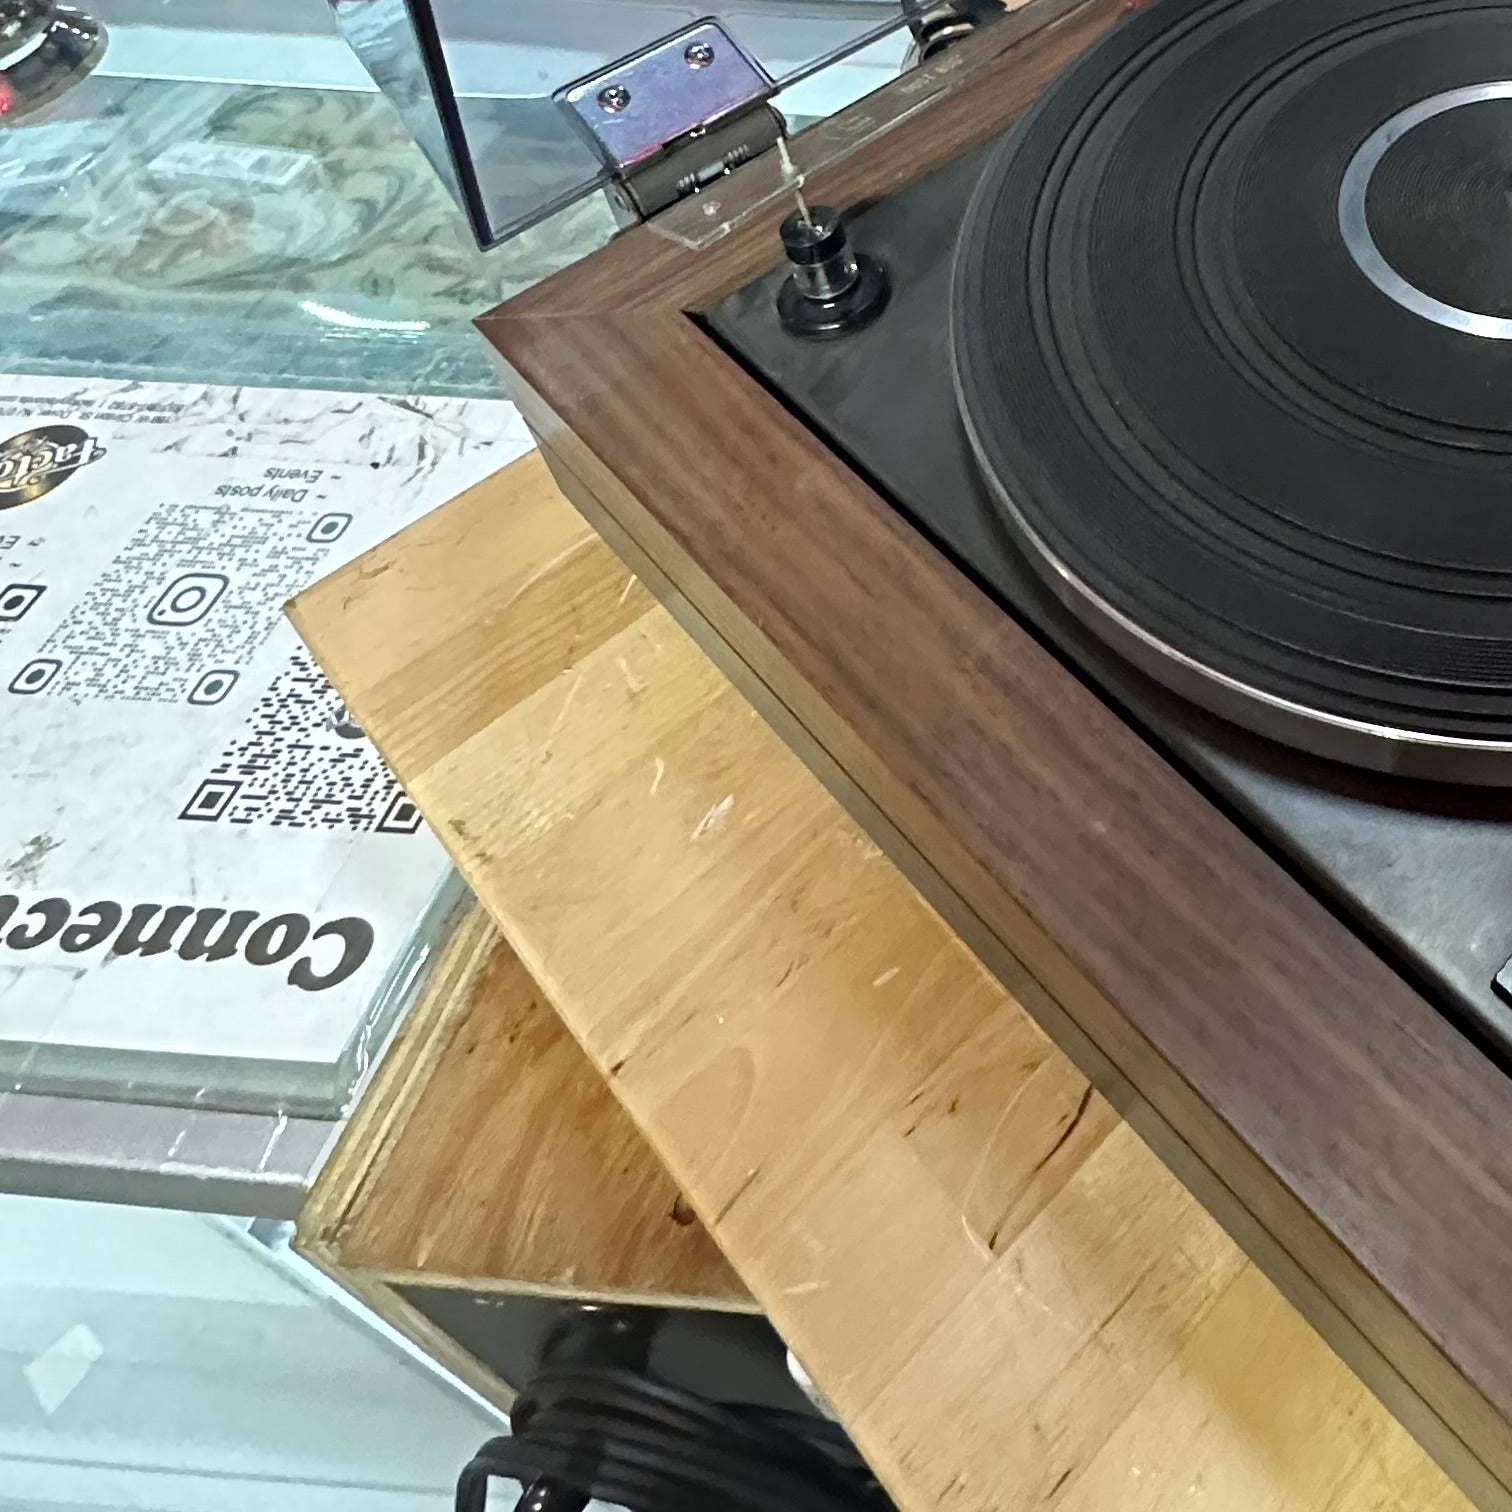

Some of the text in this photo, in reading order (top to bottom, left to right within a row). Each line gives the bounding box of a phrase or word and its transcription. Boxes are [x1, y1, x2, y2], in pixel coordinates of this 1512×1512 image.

[263, 466, 325, 484] Events
[214, 483, 309, 504] Daily posts
